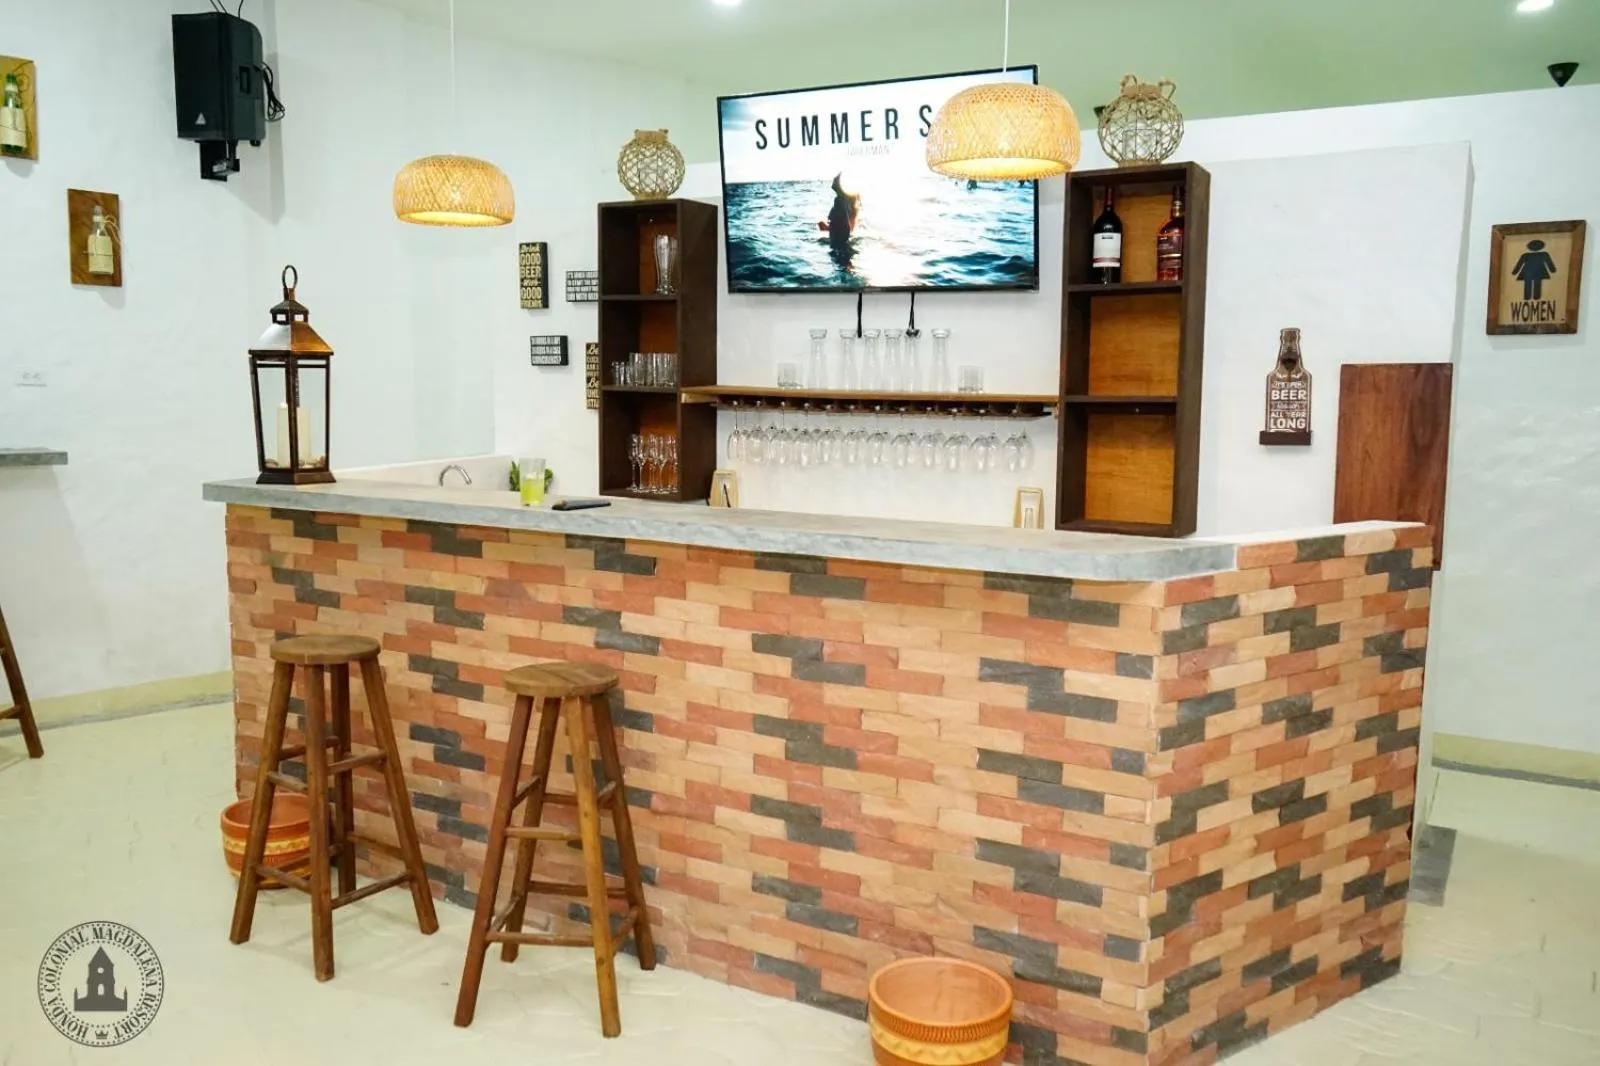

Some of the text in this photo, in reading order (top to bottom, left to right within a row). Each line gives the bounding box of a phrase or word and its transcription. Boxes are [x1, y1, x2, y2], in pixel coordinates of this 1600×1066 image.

[755, 104, 933, 150] SUMMER S
[520, 253, 541, 265] GOOD
[520, 266, 541, 278] BEER
[521, 287, 542, 299] GOOD
[1510, 300, 1556, 322] WOMEN
[1271, 390, 1307, 400] BEER
[1270, 418, 1306, 429] LONG
